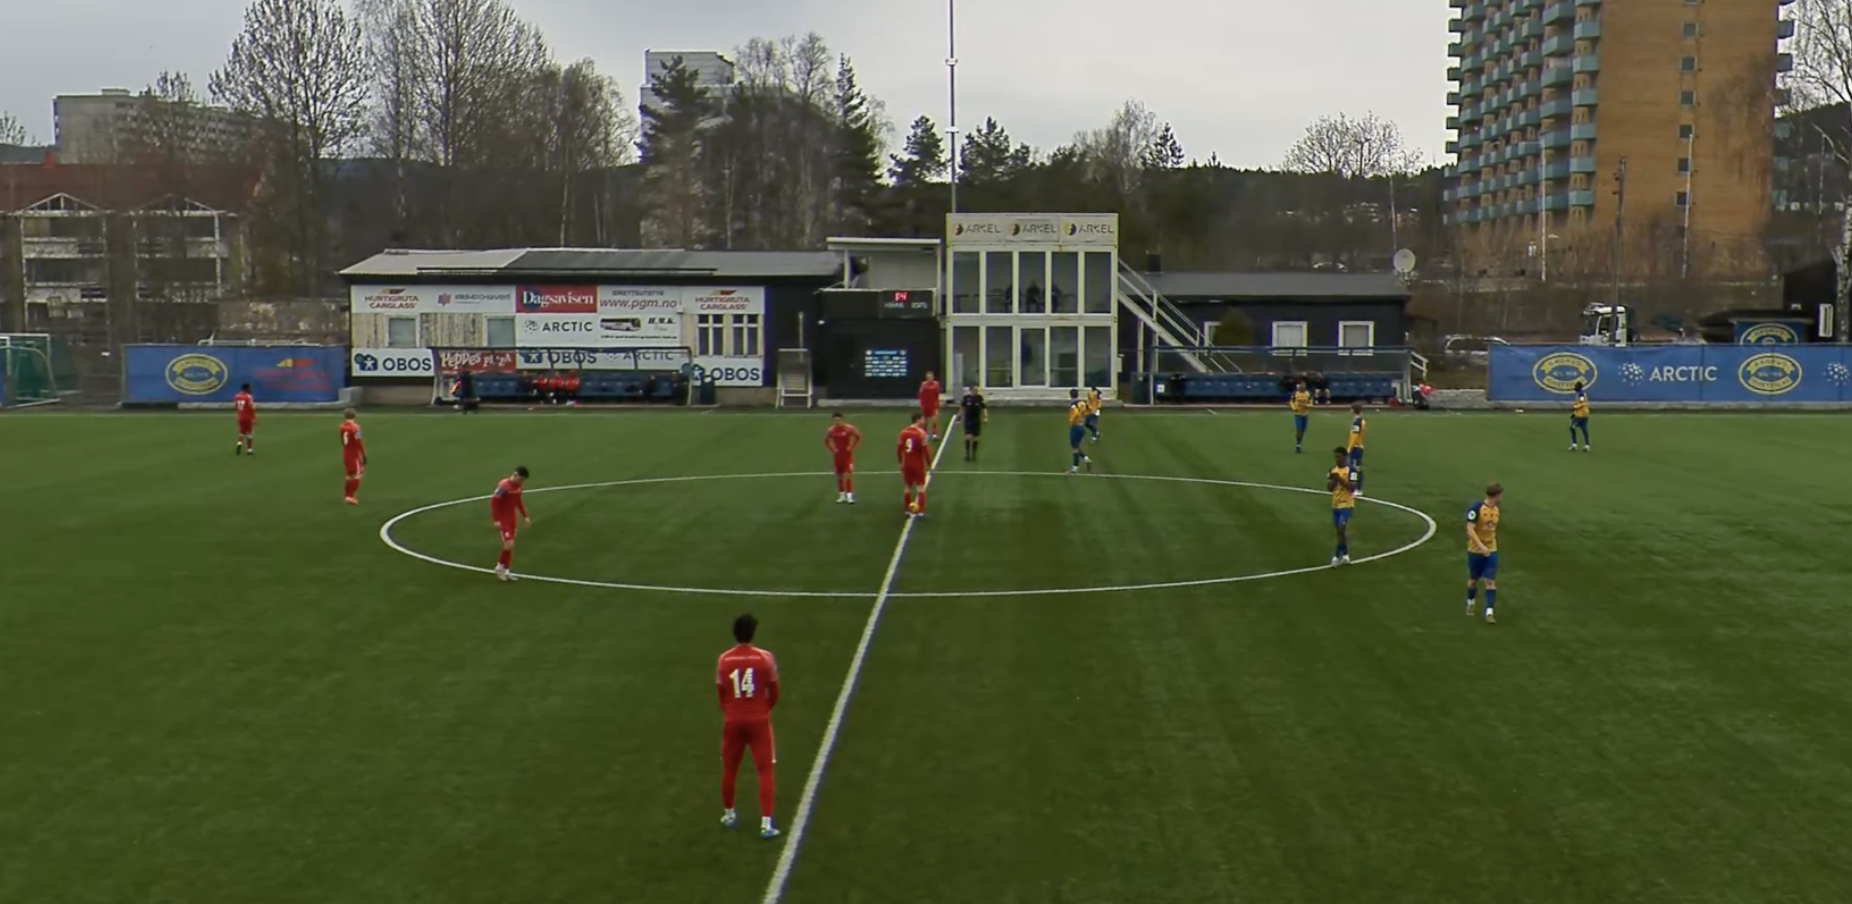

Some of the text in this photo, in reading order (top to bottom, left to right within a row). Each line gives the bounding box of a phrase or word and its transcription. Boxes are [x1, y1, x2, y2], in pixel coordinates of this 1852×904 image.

[965, 223, 1001, 233] ARKEL
[1022, 223, 1057, 234] ARKEL
[1078, 223, 1114, 234] ARKEL
[522, 291, 594, 308] Dagsavisen
[600, 298, 677, 310] www.pgm.no
[542, 321, 593, 332] ARCTIC
[382, 357, 432, 371] OBOS
[710, 367, 760, 381] OBOS
[1649, 366, 1717, 381] ARCTIC
[905, 438, 913, 453] 9
[729, 667, 754, 698] 14
